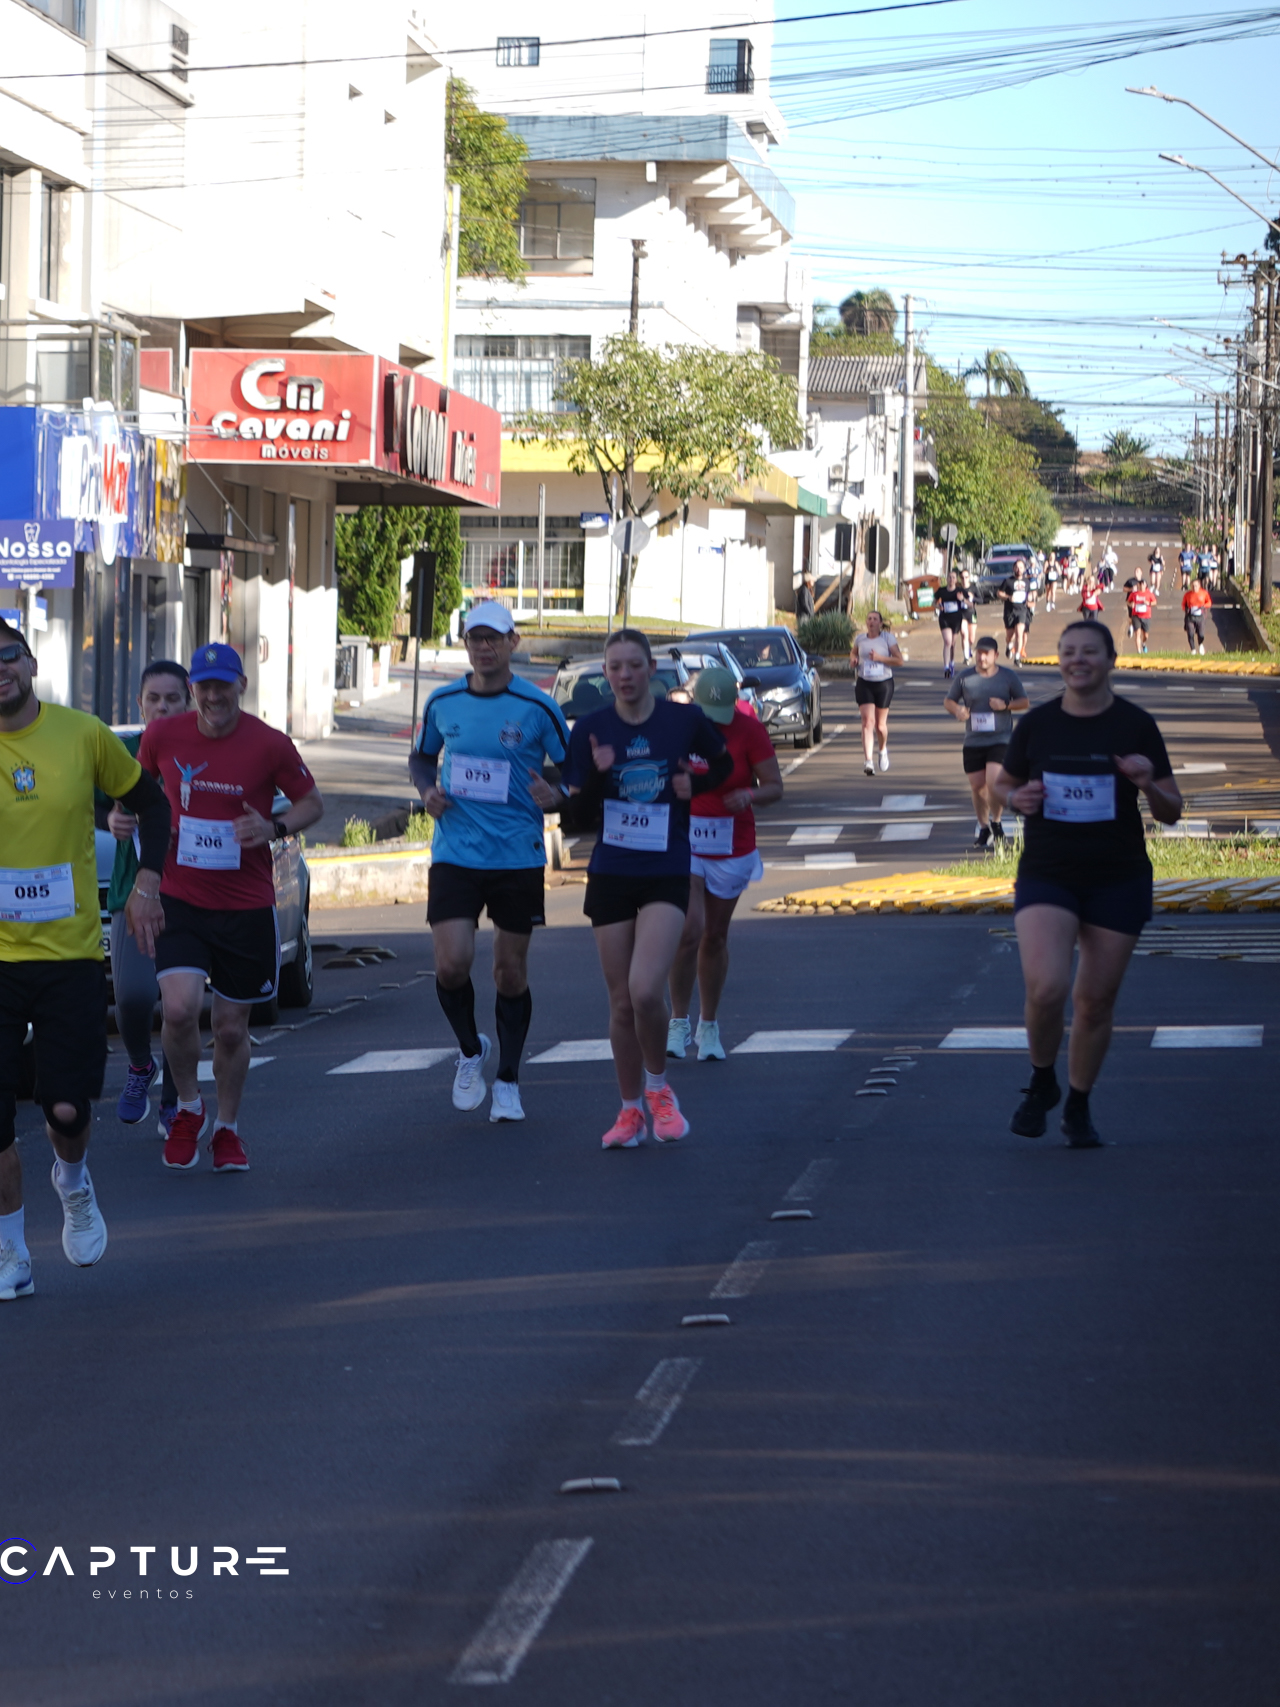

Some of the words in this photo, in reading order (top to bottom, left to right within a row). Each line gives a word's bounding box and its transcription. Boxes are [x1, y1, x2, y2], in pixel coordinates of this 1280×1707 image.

[212, 409, 352, 442] Cavani
[261, 443, 329, 460] móveis
[465, 767, 491, 783] 079
[1063, 786, 1094, 800] 205
[621, 813, 649, 828] 220
[194, 833, 223, 849] 206
[694, 827, 717, 839] 011
[14, 884, 50, 900] 085
